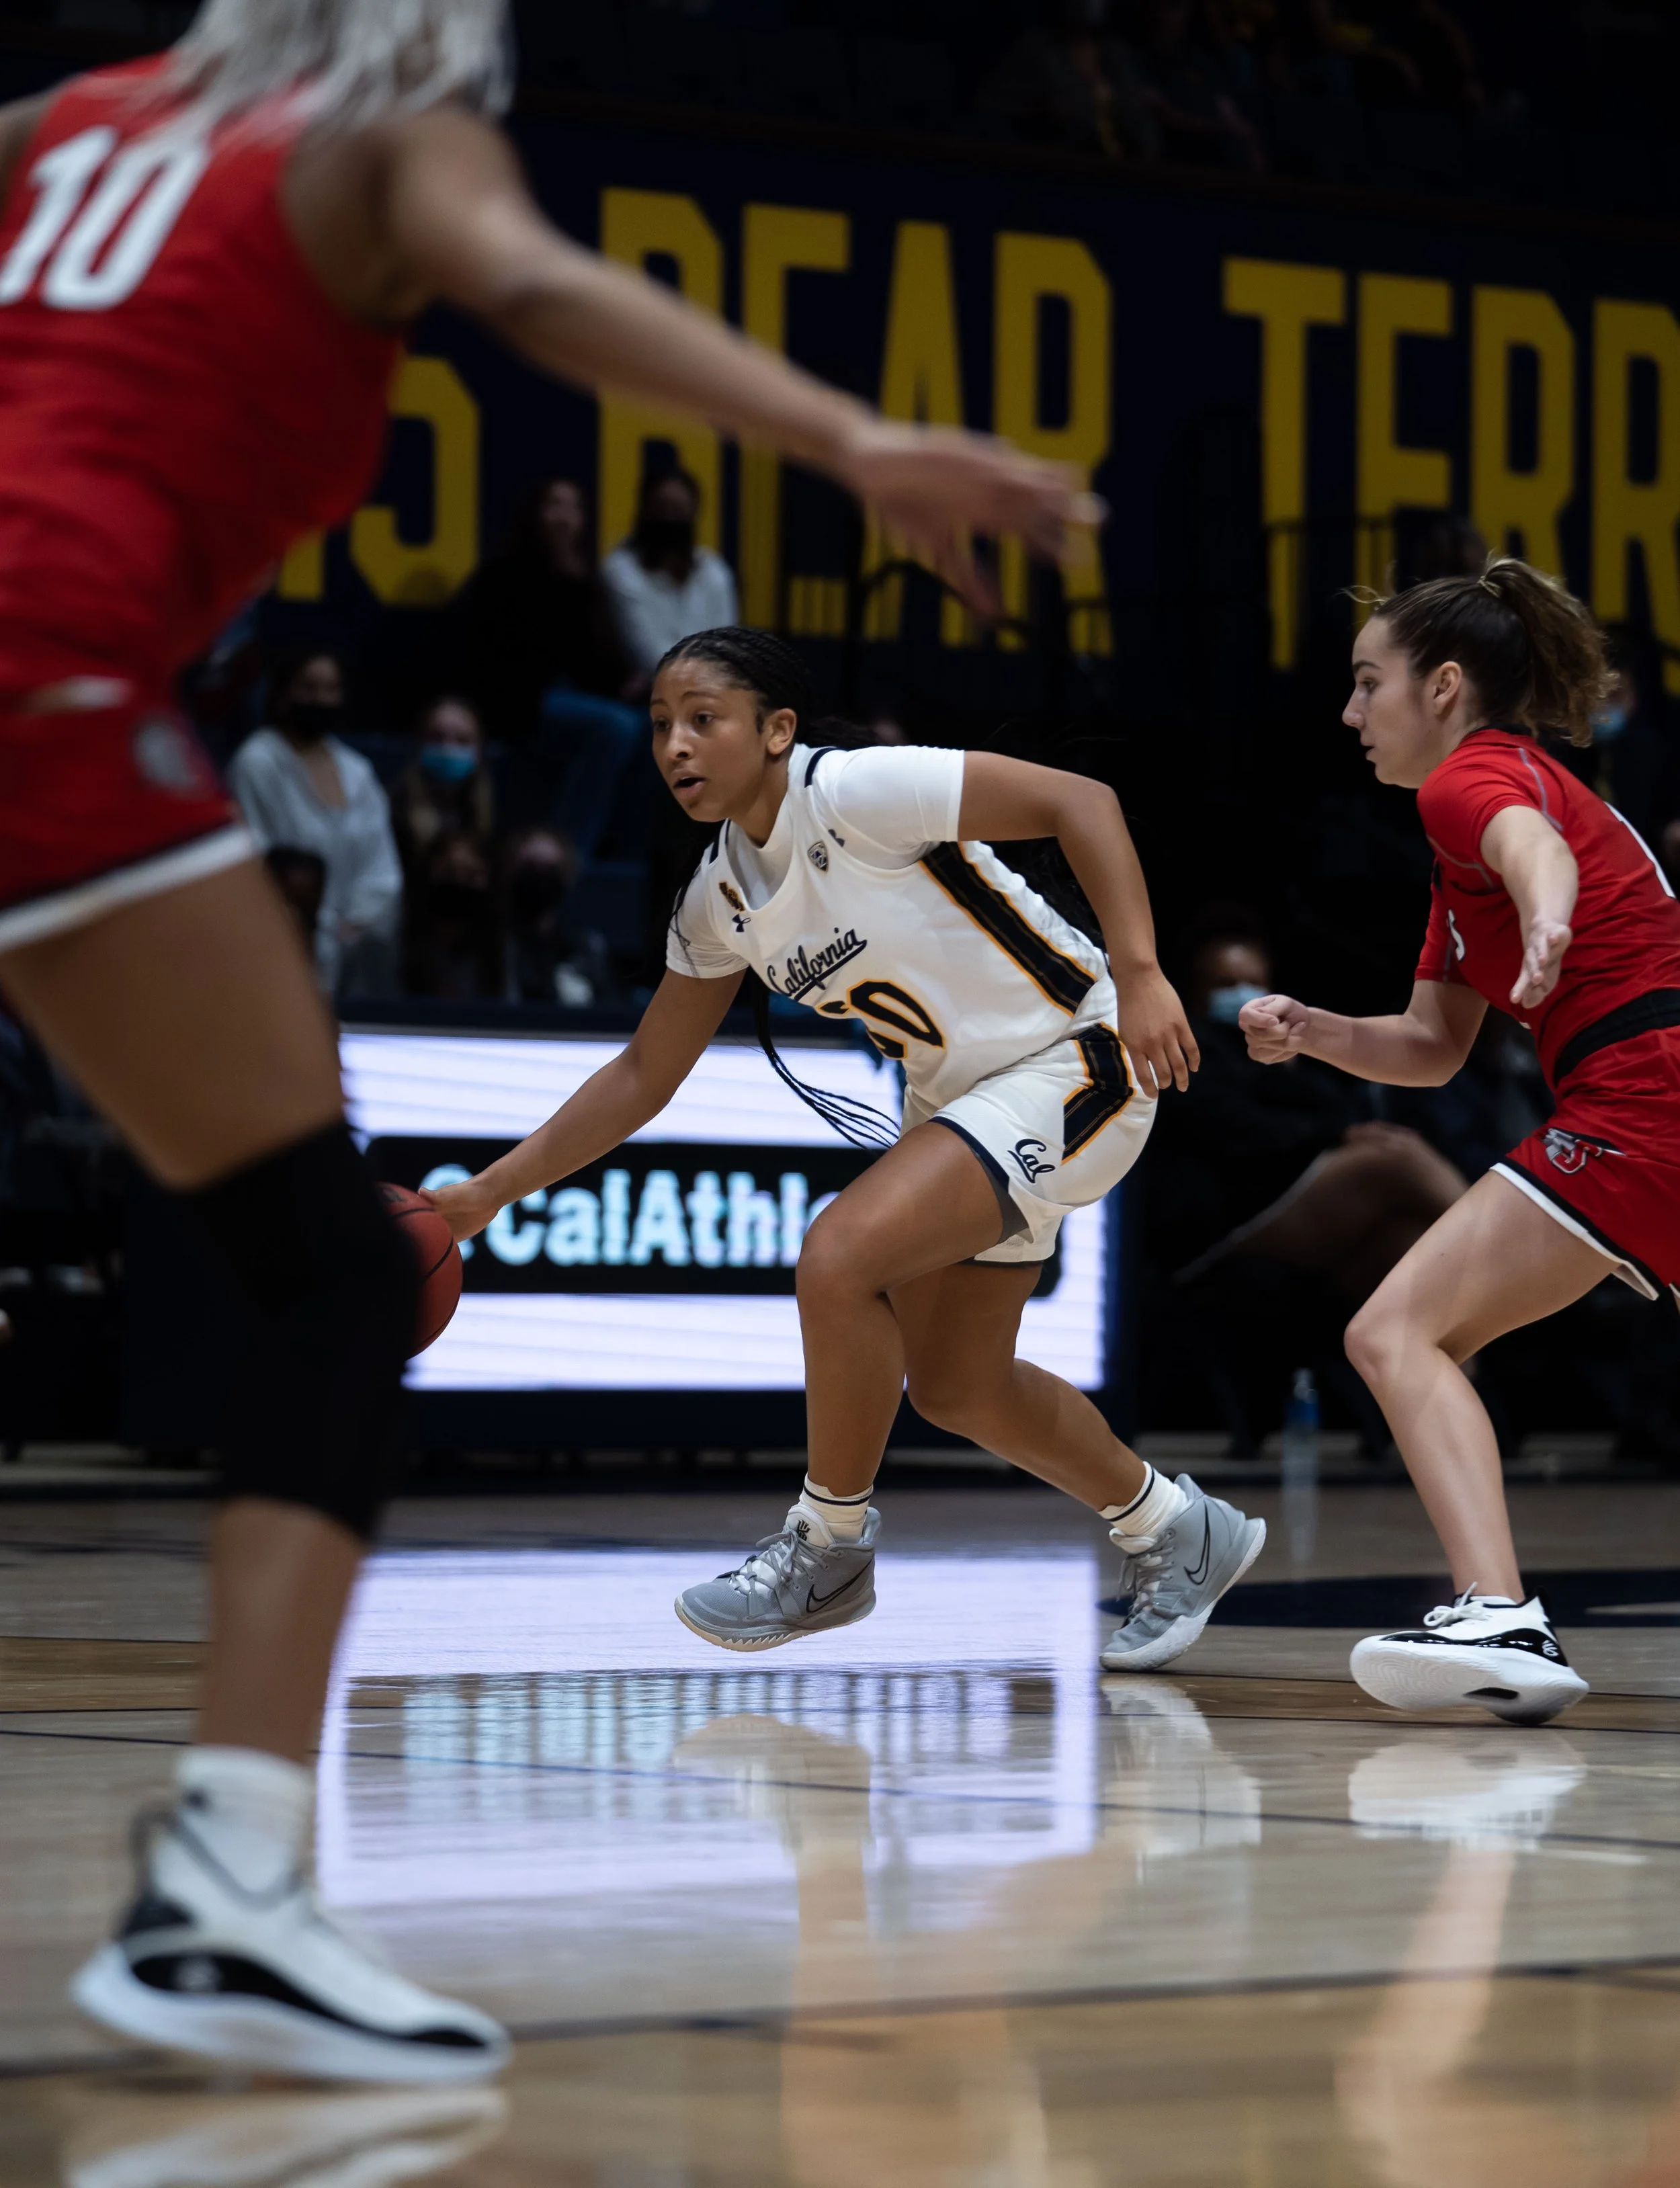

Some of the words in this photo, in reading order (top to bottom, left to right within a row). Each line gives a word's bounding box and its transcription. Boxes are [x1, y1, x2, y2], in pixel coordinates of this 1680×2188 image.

[0, 125, 208, 310] 10
[598, 186, 1114, 657] BEAR
[767, 927, 867, 1001] California
[1007, 1138, 1055, 1183] Cal
[419, 1163, 841, 1269] CalAthl
